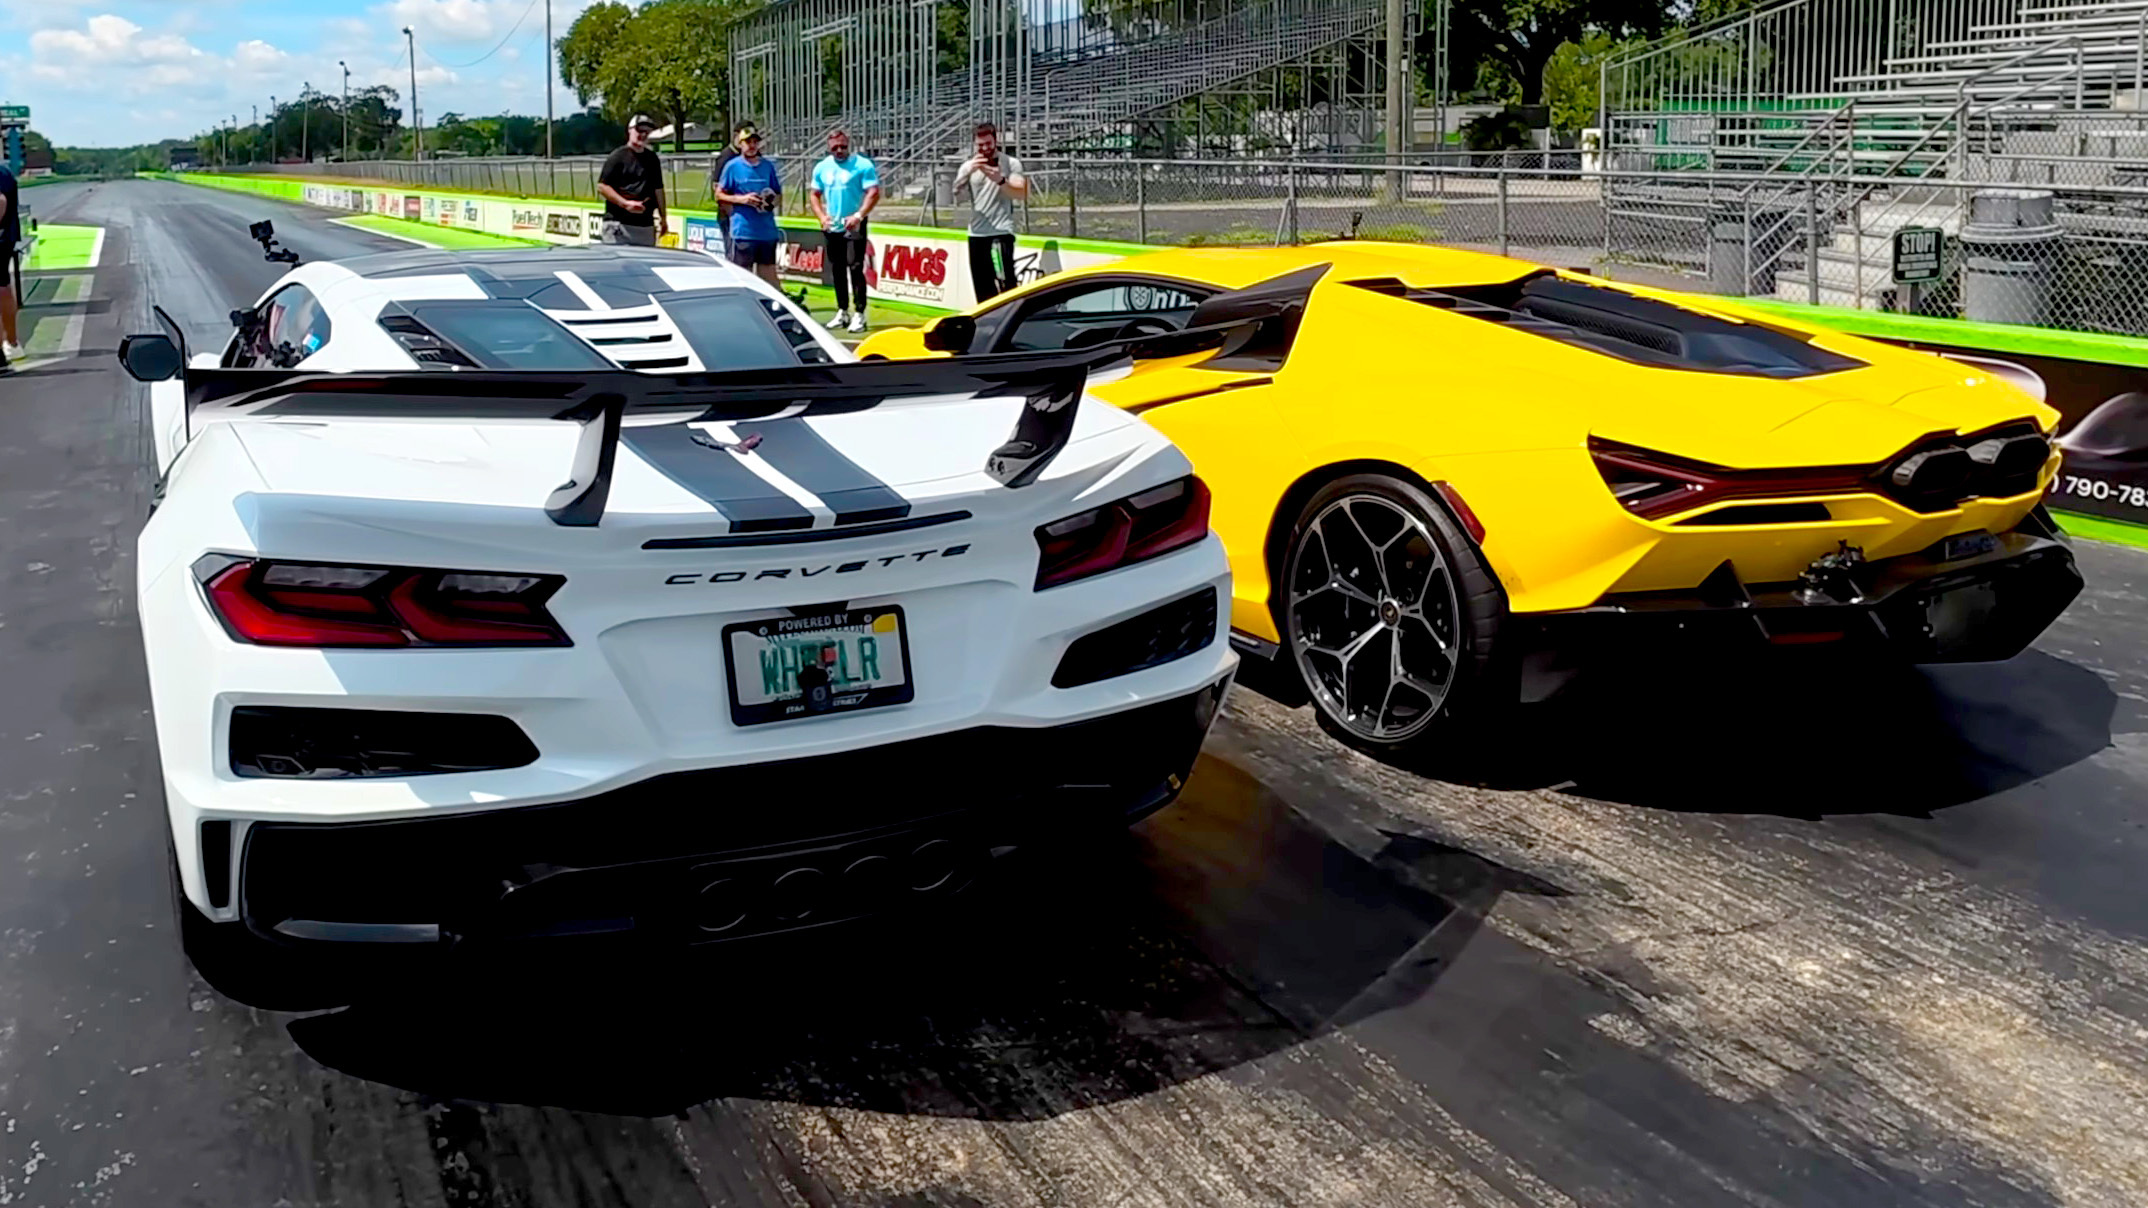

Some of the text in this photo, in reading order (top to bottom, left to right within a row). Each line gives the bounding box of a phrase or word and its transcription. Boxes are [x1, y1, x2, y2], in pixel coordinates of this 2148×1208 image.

[512, 209, 543, 229] FuelTech
[1901, 232, 1936, 254] STOP!
[881, 244, 948, 286] KINGS
[2065, 475, 2148, 508] 790-78
[665, 543, 972, 585] CORVETTE
[778, 613, 849, 632] POWERED BY
